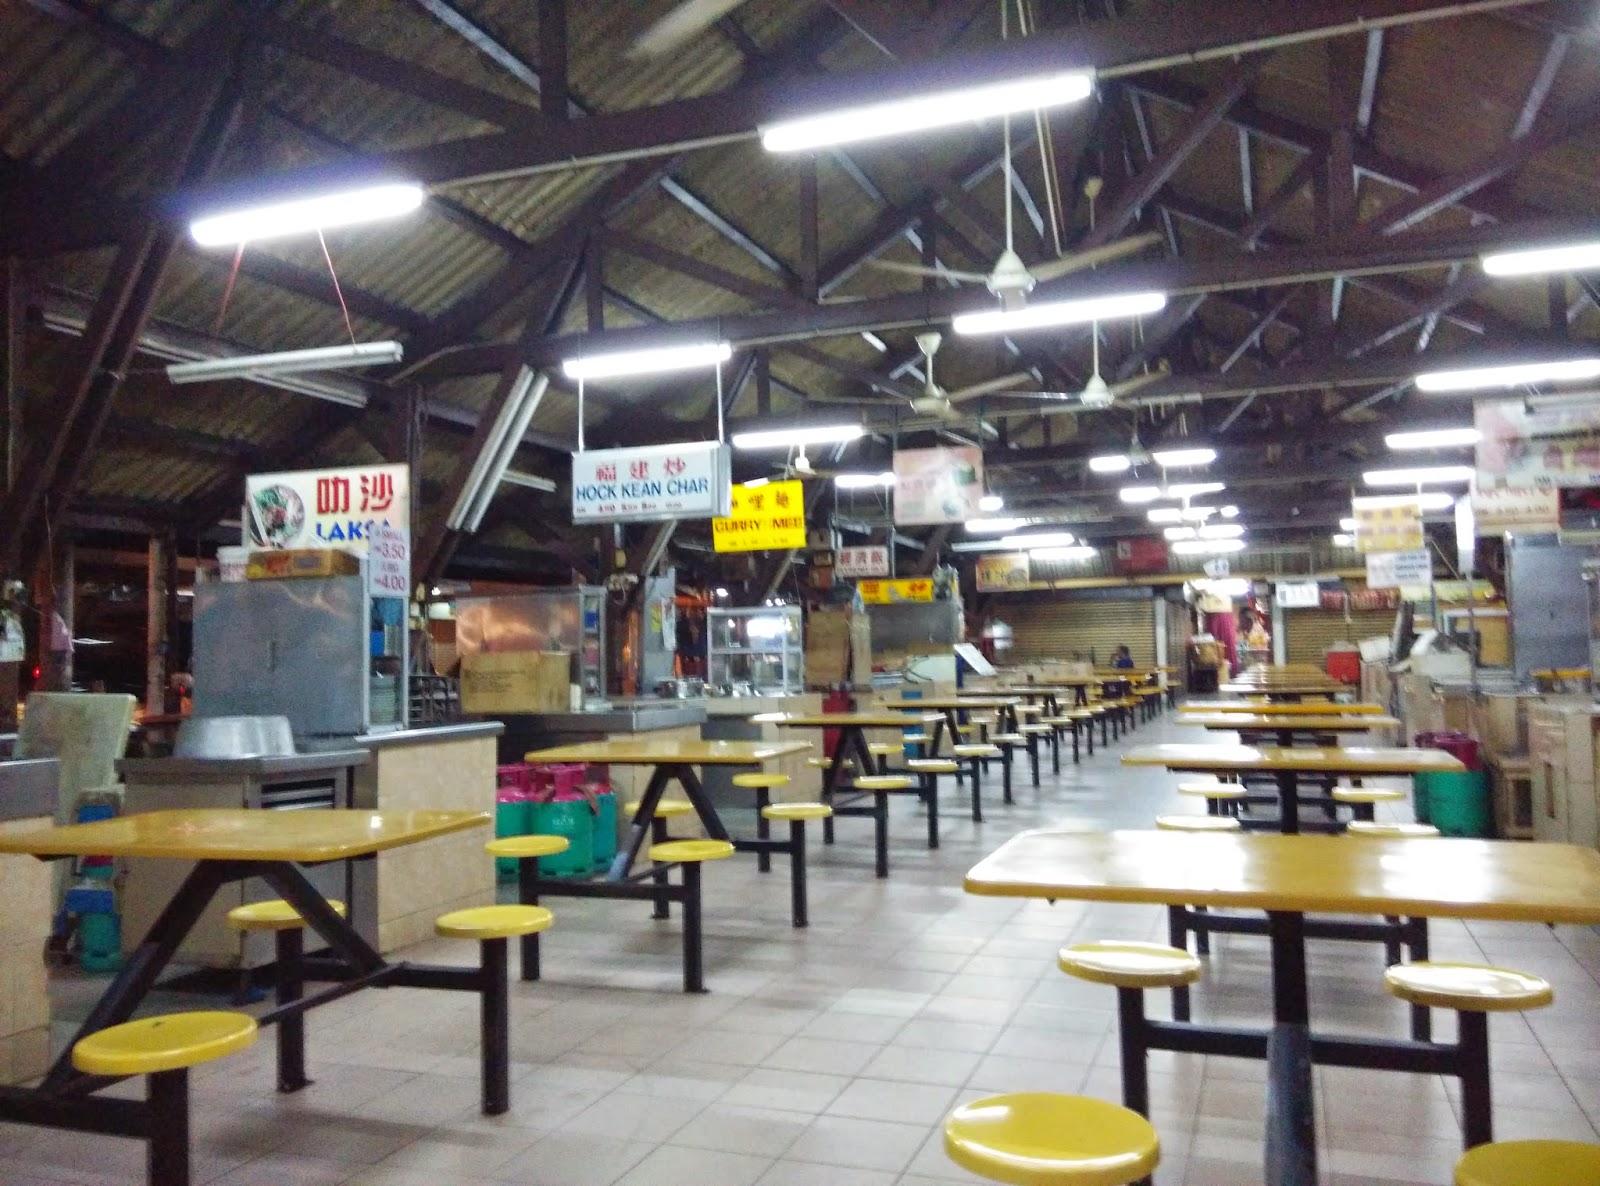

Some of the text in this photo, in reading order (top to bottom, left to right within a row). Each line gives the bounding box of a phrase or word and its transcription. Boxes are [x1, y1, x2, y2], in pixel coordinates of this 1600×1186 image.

[316, 473, 394, 515] 叻沙
[576, 476, 709, 501] HOCK KEAN CHAR
[316, 518, 391, 541] LAK
[715, 520, 760, 533] CURRY
